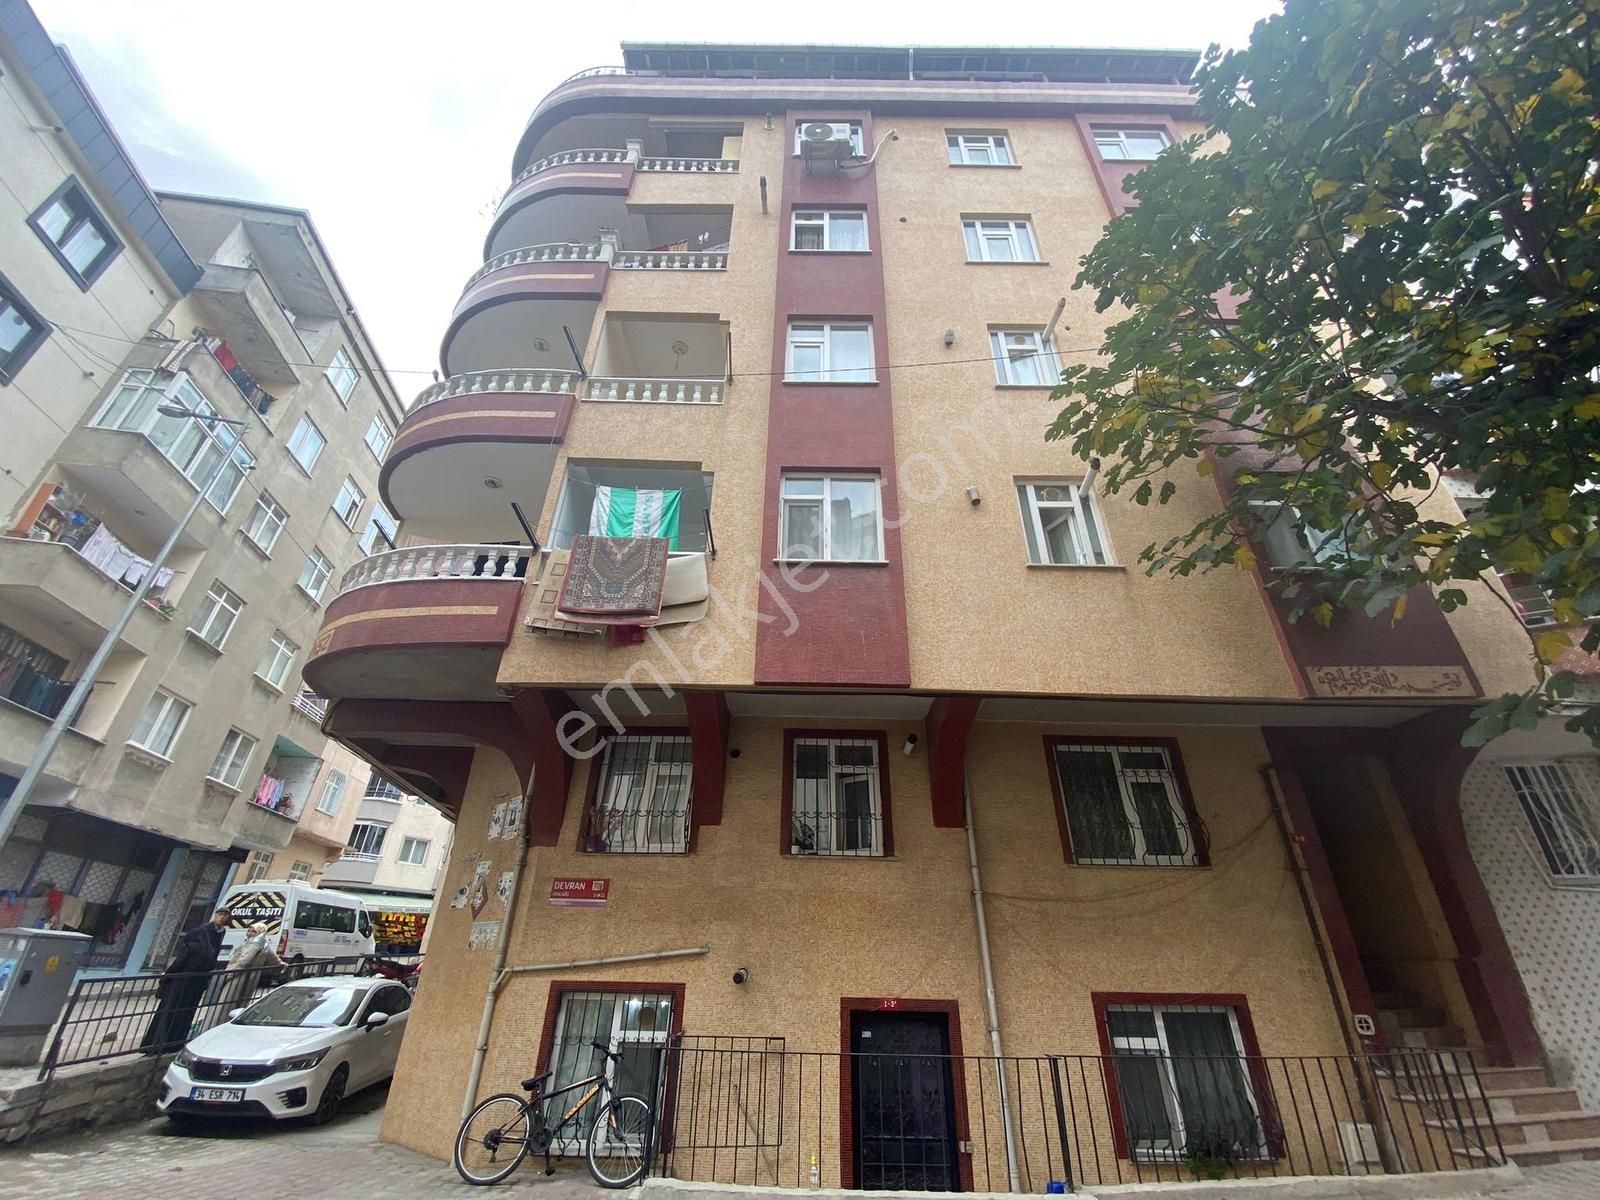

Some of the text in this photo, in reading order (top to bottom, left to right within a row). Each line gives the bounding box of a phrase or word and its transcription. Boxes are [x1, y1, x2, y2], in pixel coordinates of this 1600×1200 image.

[554, 881, 586, 890] DEVRAN
[231, 908, 282, 917] OKUL TAŞITI
[195, 1090, 240, 1100] 34 ESR 714
